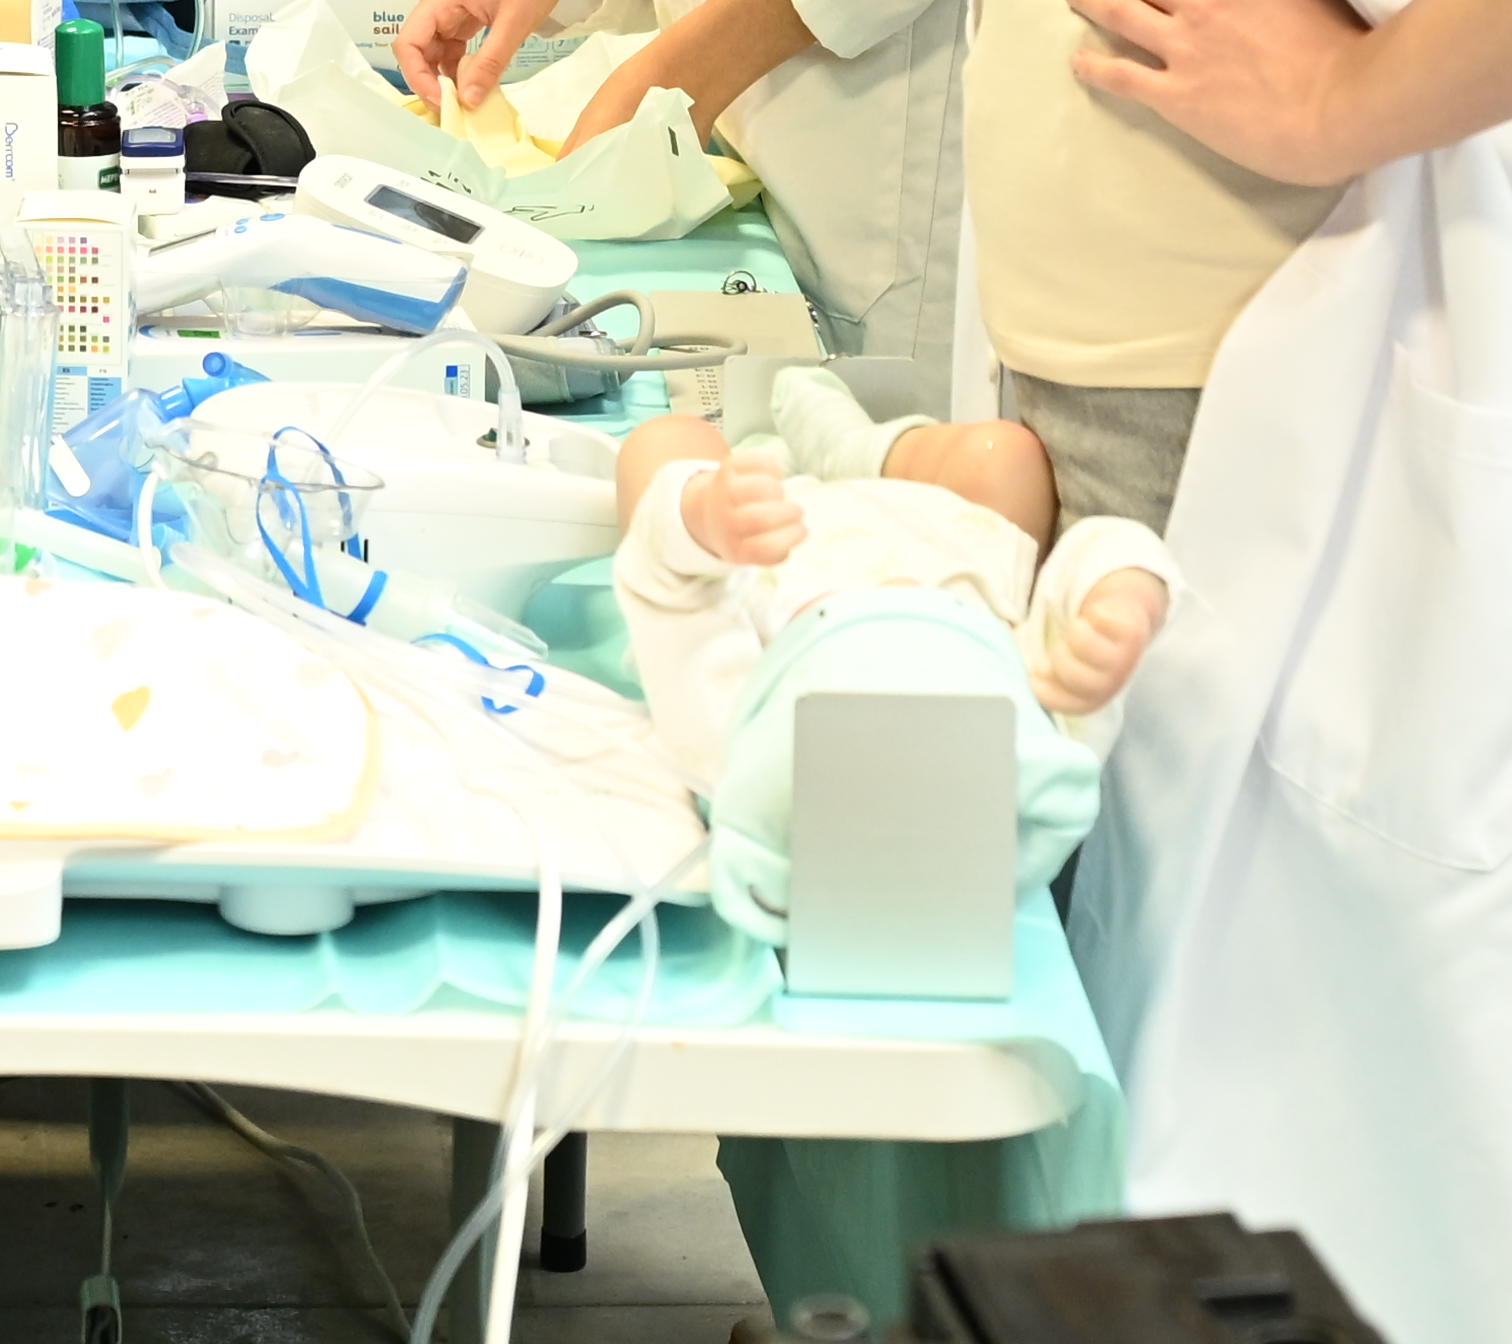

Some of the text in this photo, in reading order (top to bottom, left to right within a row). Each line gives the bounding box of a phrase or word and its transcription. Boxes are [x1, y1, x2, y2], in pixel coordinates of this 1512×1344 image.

[373, 10, 405, 22] blue
[228, 24, 262, 36] Exam
[373, 23, 400, 35] sail
